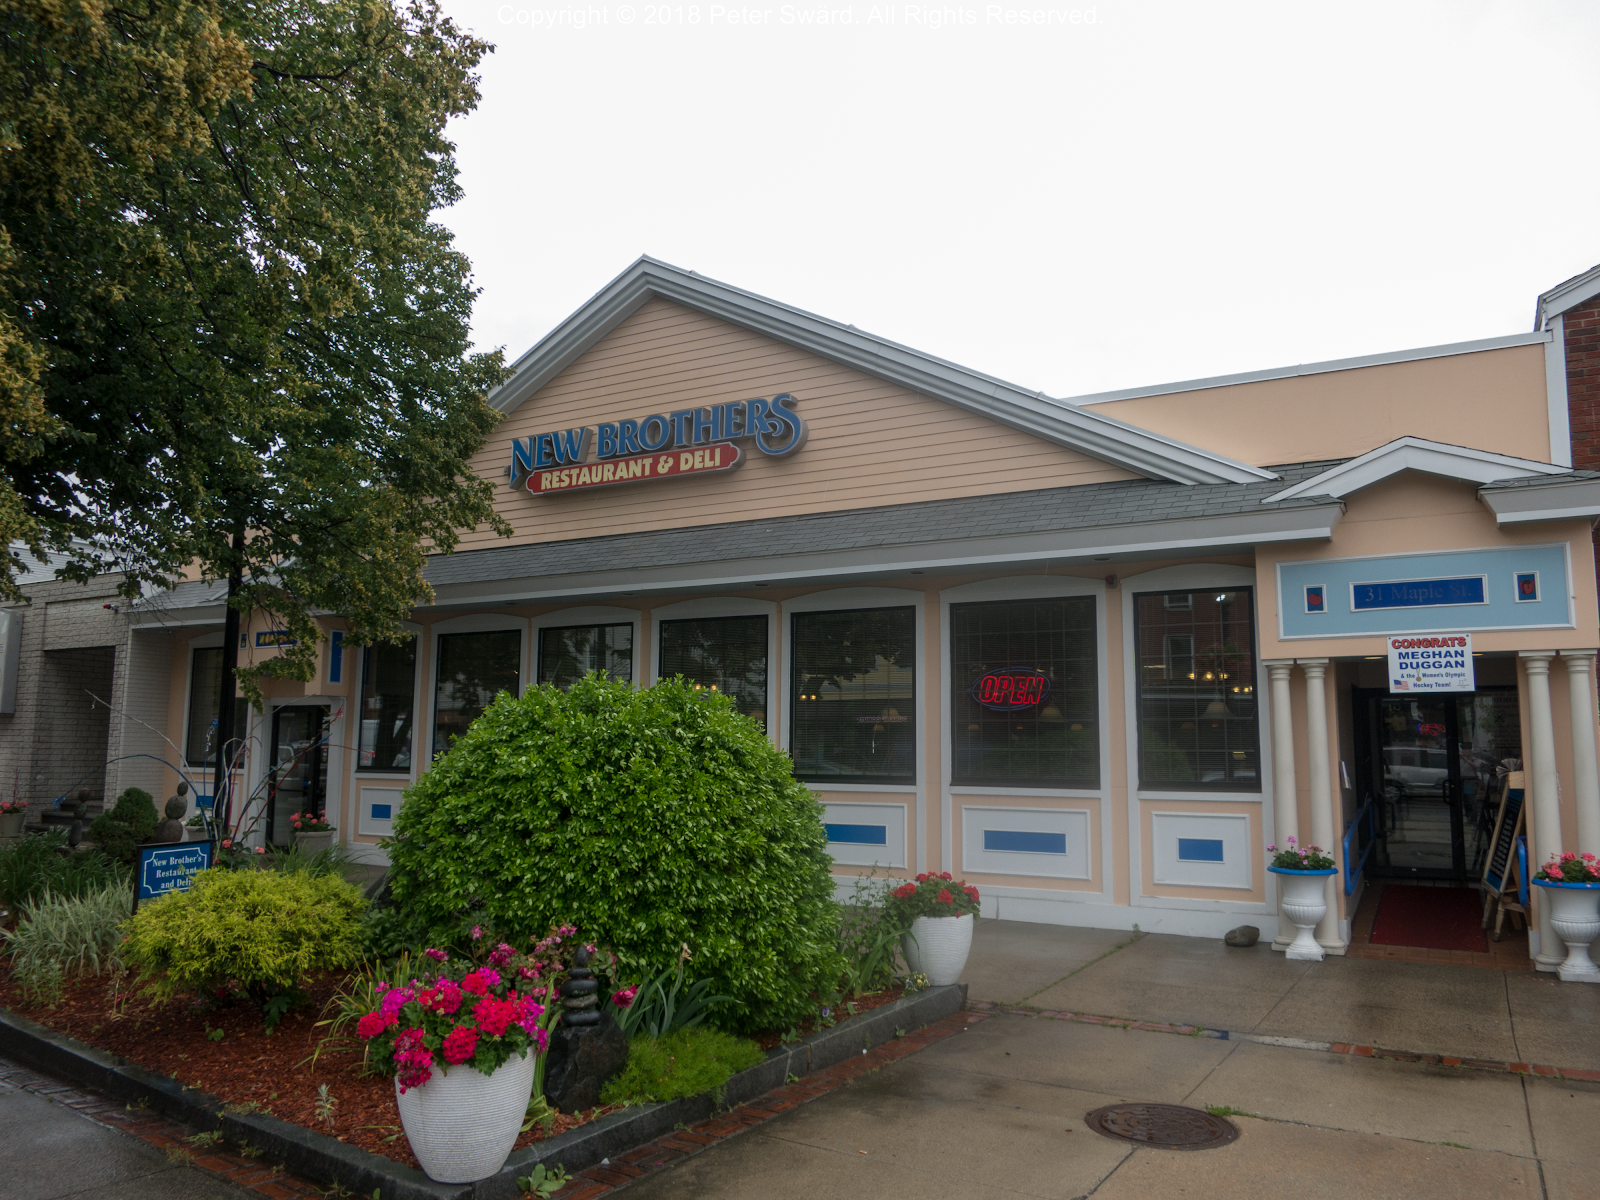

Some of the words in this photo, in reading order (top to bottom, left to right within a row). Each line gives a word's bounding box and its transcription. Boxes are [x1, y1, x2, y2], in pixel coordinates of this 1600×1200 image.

[509, 427, 590, 488] NEW
[597, 393, 807, 457] BROTHERS
[540, 458, 653, 490] RESTAURANT
[657, 455, 674, 474] &
[679, 447, 721, 472] DELI
[1365, 587, 1383, 602] 31
[1391, 583, 1444, 603] Maple
[1449, 581, 1472, 597] St.
[1391, 636, 1467, 649] CONGRATS
[1398, 650, 1465, 660] MEGHAN
[1399, 660, 1465, 670] DUGGAN
[978, 675, 1044, 705] OPEN
[152, 858, 167, 867] New
[169, 854, 202, 865] Brother's
[160, 879, 174, 889] and
